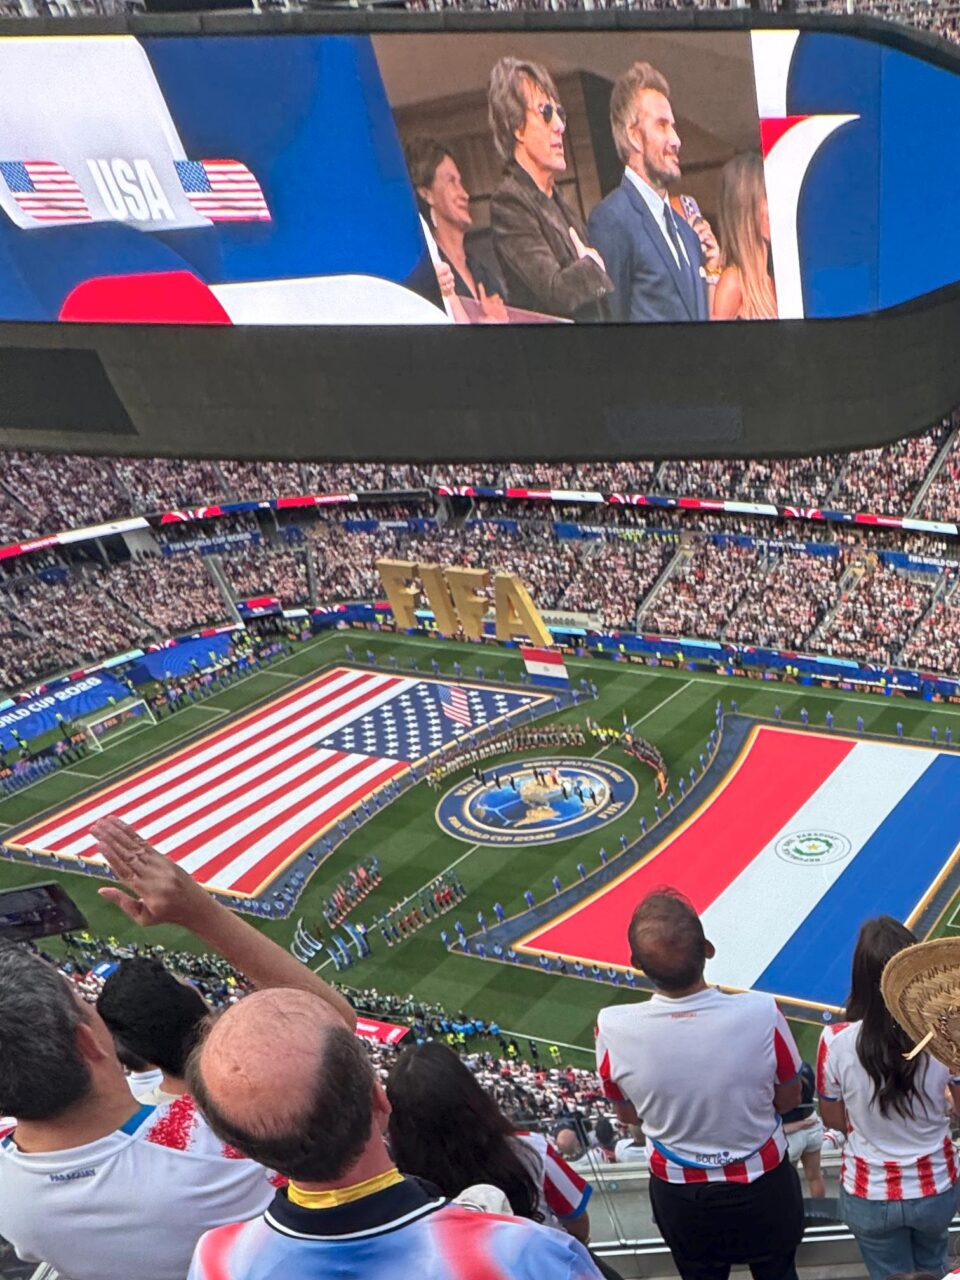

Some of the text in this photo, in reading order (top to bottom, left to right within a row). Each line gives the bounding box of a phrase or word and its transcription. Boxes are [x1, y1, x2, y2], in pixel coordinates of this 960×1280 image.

[87, 159, 175, 222] USA
[376, 558, 554, 647] FIFA
[28, 696, 56, 712] CUP
[54, 677, 102, 701] 2026
[598, 801, 624, 819] FIFA
